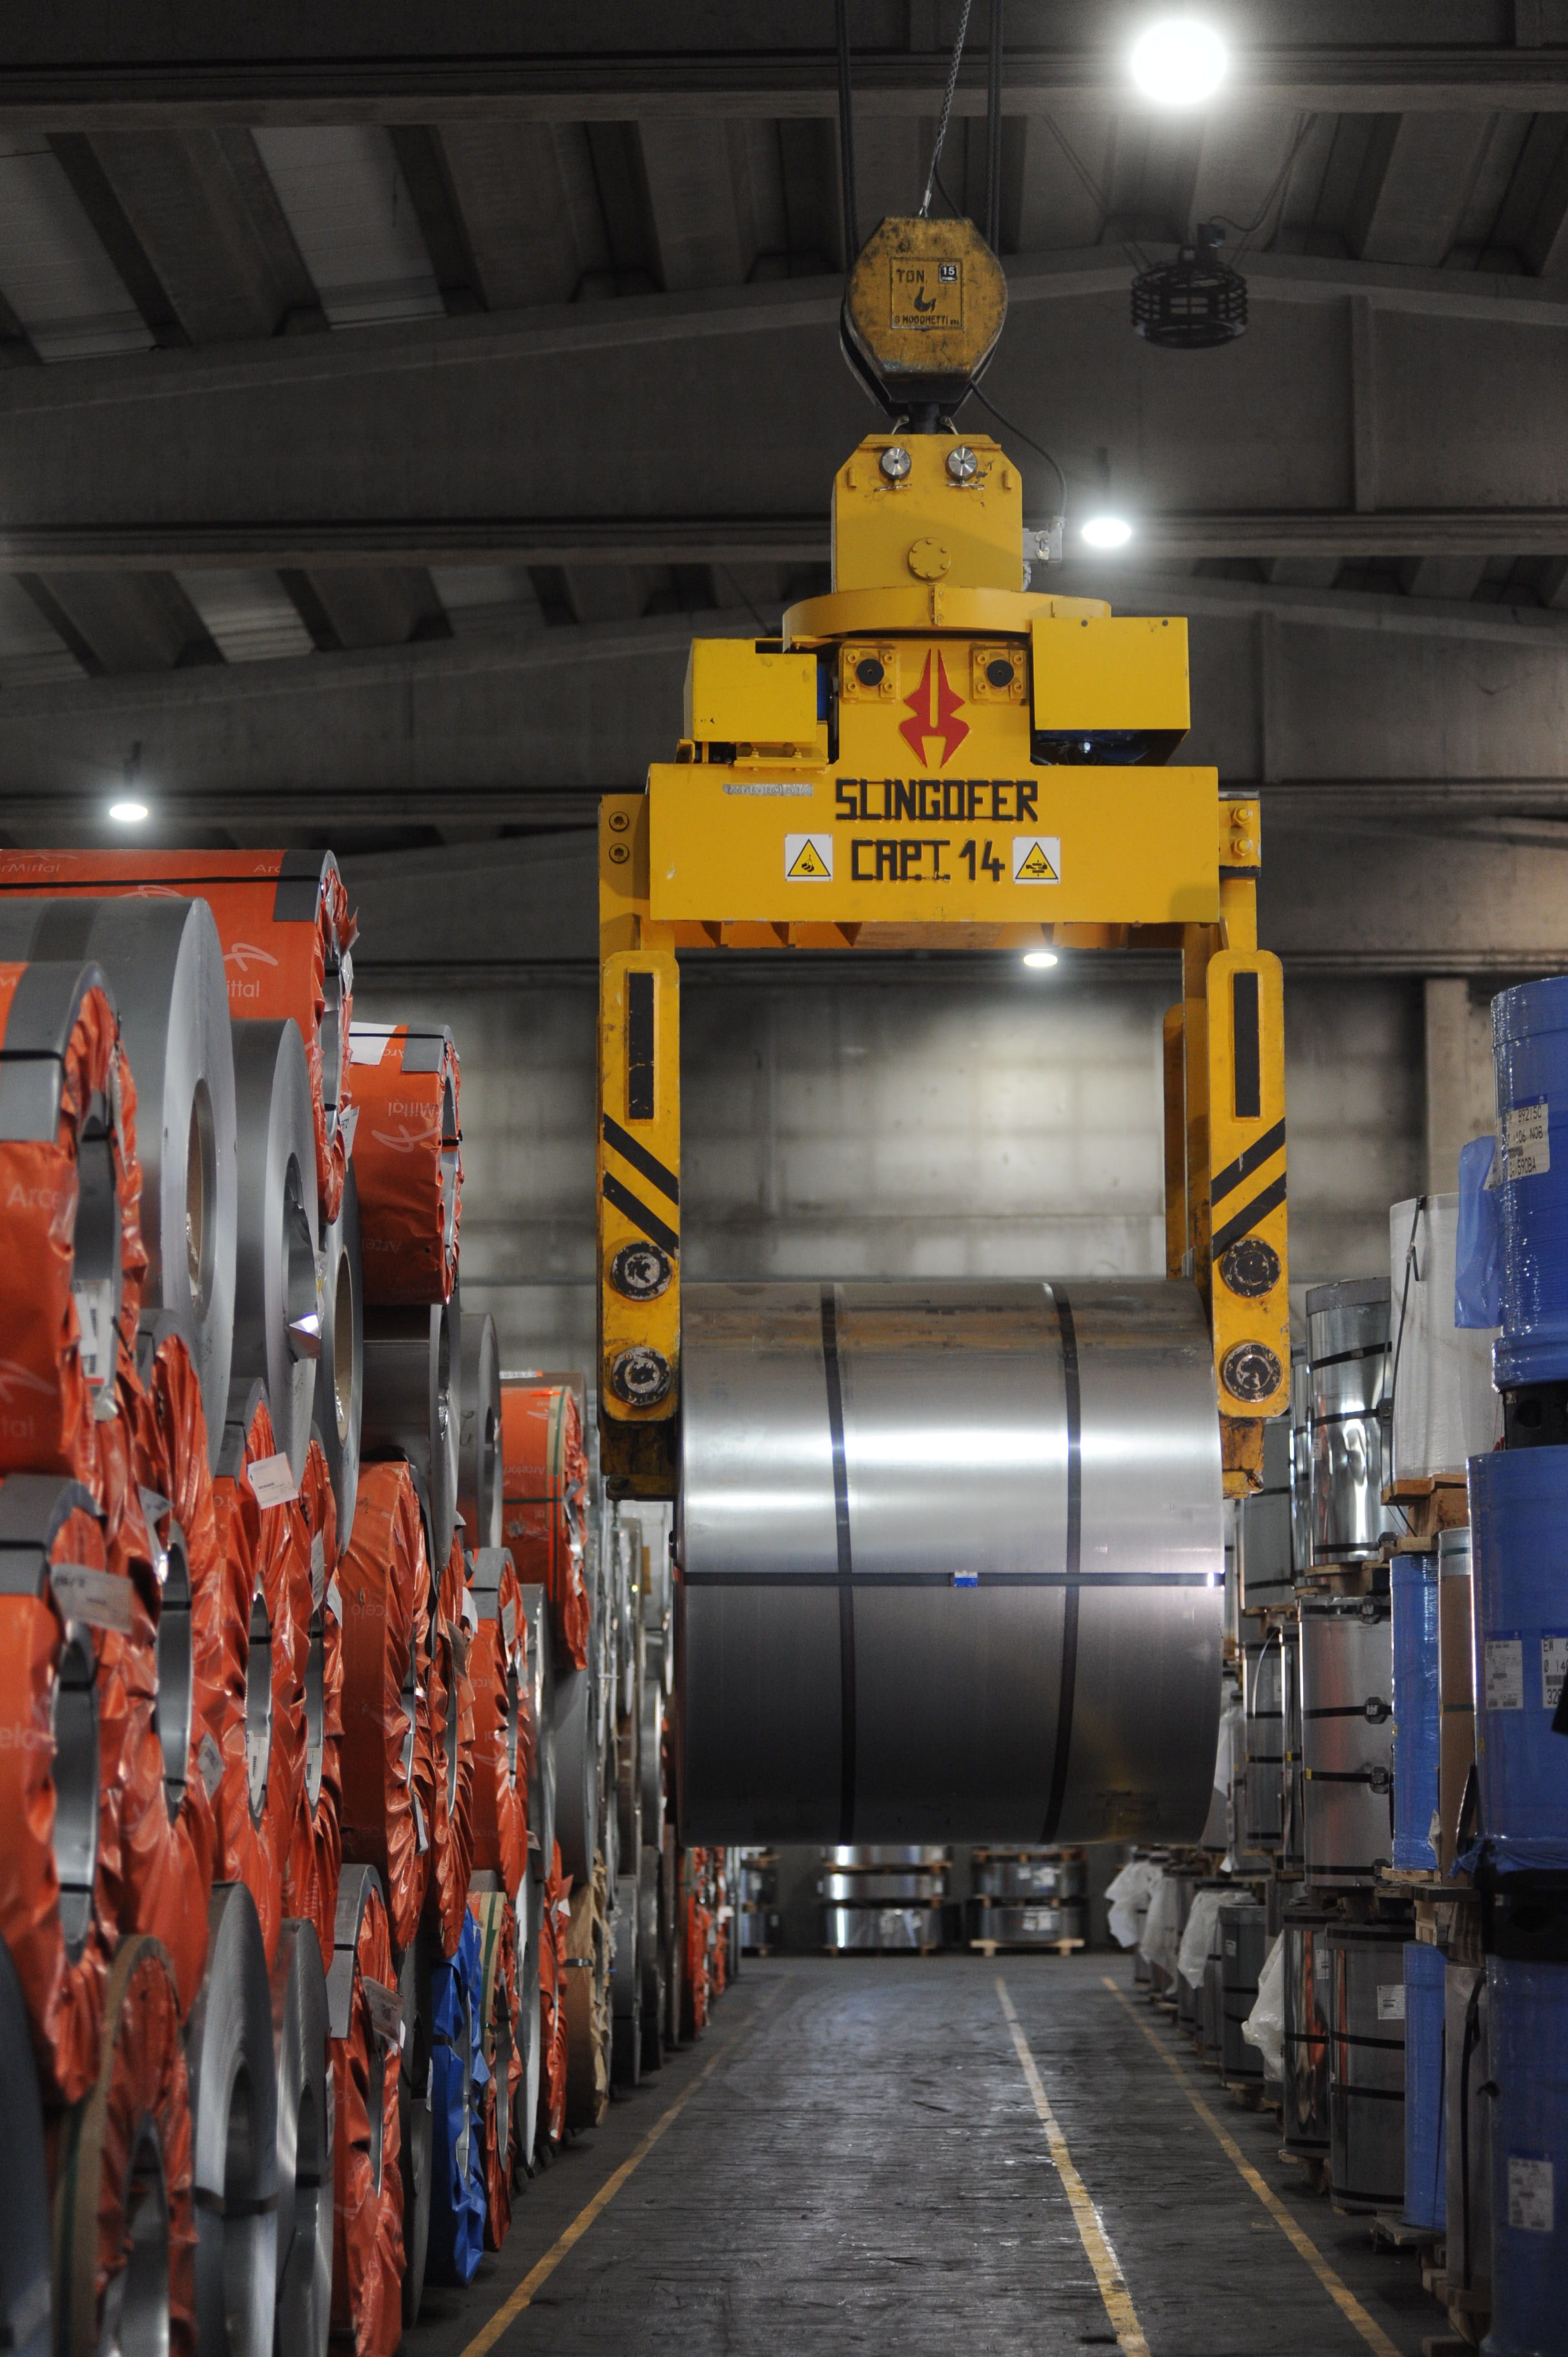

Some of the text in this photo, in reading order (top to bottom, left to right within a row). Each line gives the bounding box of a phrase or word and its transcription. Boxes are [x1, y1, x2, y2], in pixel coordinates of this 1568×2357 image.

[942, 266, 955, 275] 15
[836, 778, 1038, 822] SLINGOFER
[959, 838, 1006, 882] 14
[1544, 1639, 1554, 1653] EW
